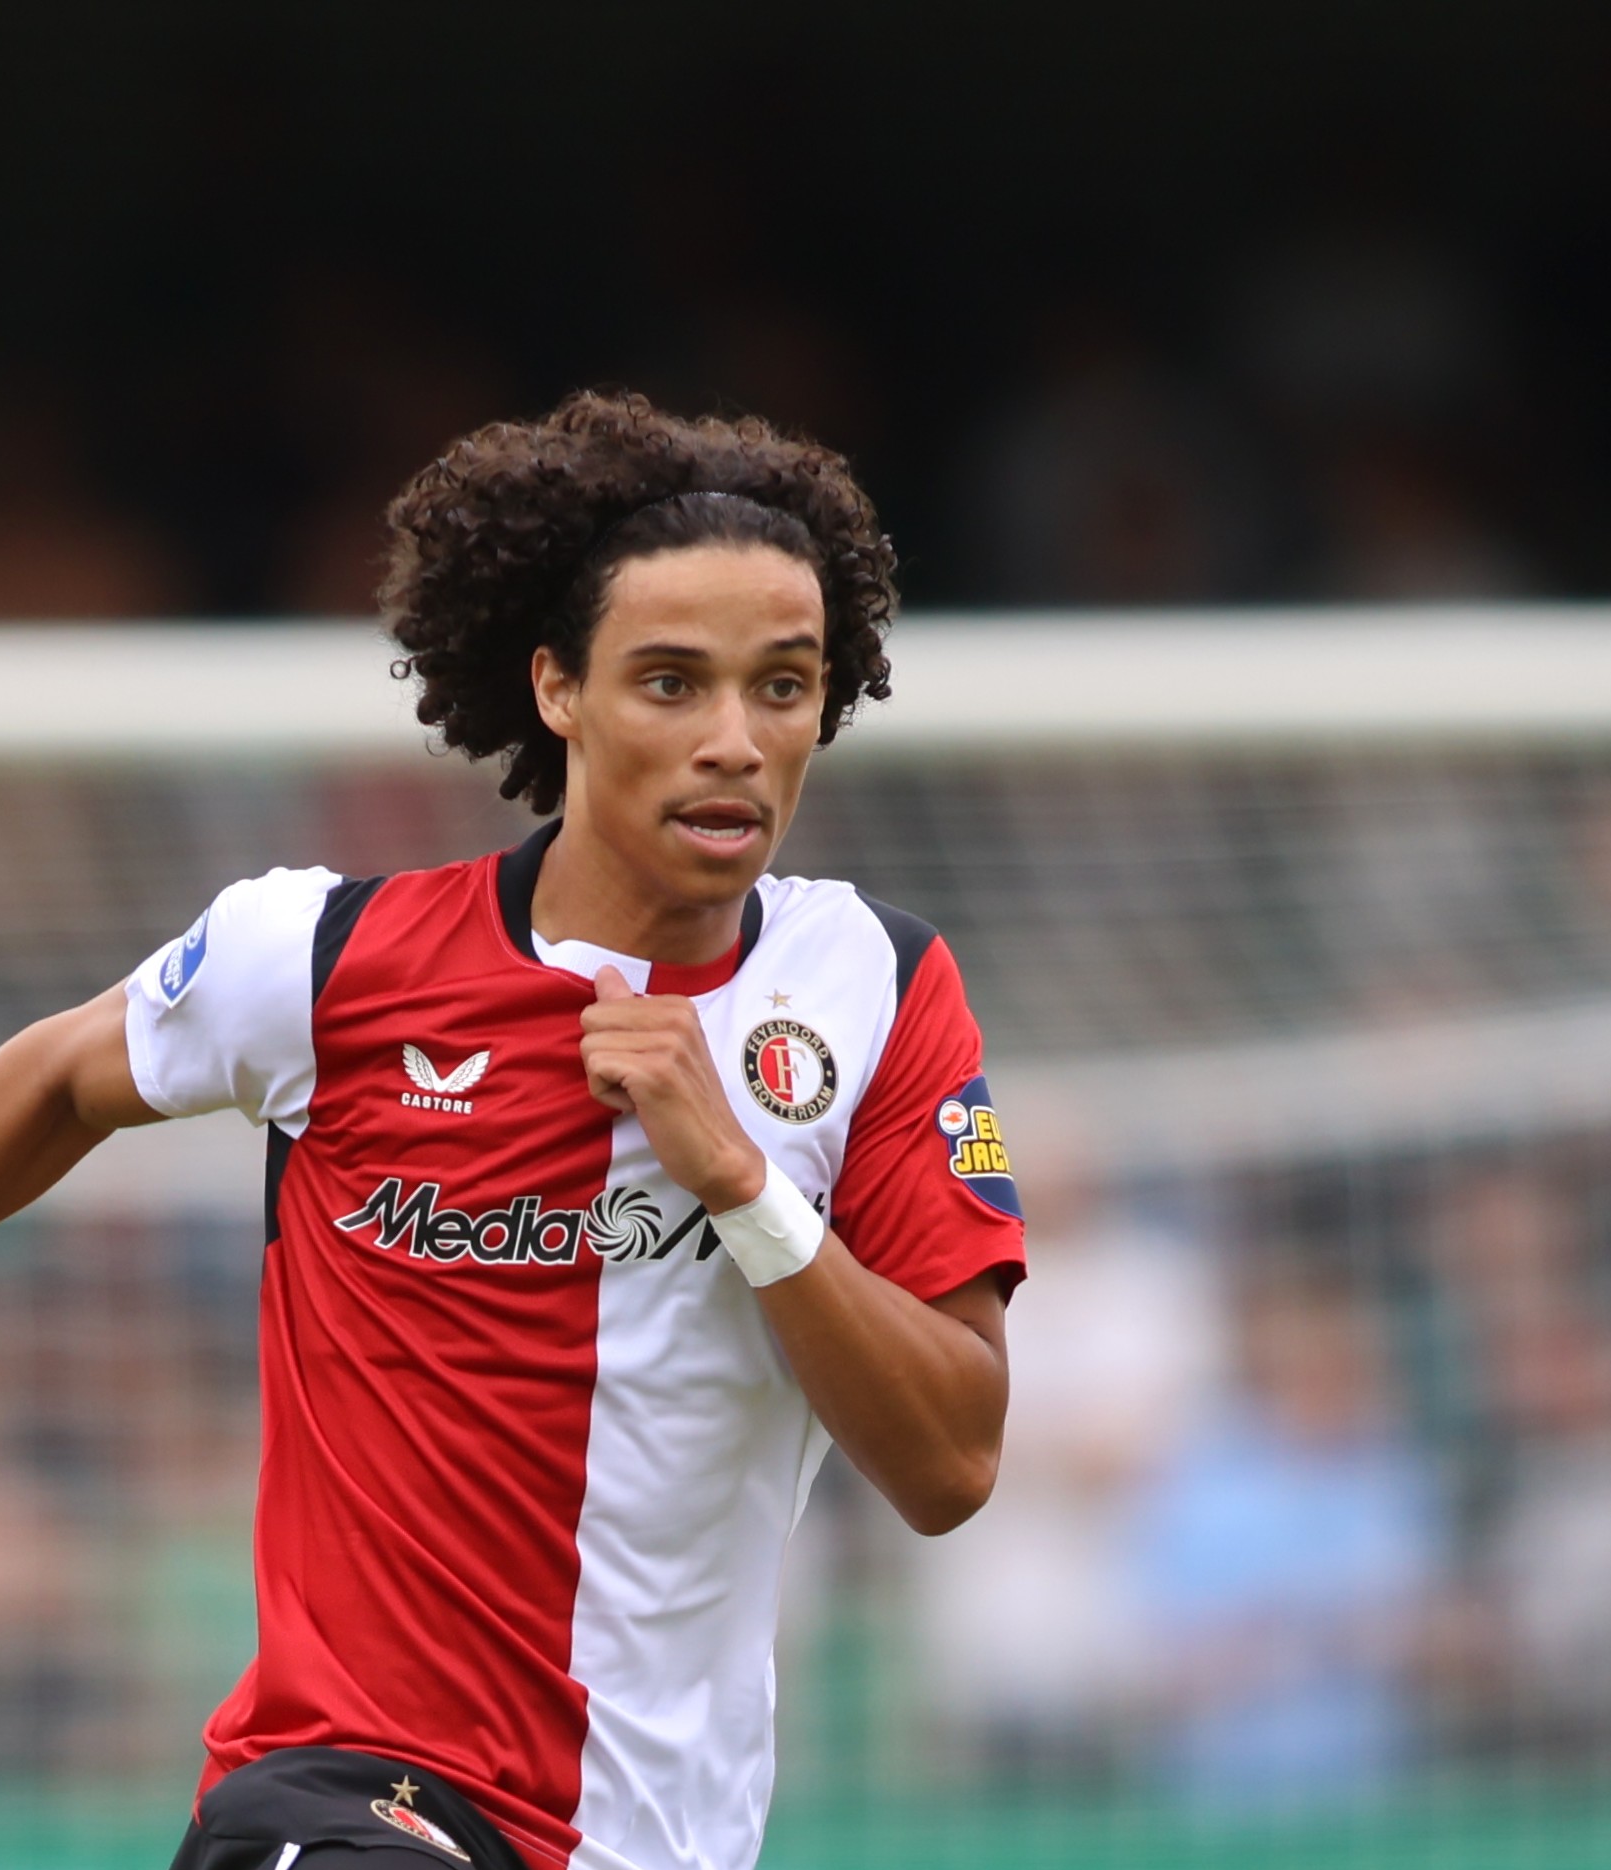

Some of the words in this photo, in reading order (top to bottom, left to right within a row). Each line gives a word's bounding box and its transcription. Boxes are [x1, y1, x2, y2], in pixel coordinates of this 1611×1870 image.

[746, 1020, 830, 1060] FEYENOORD
[401, 1092, 473, 1115] CASTORE
[750, 1079, 835, 1120] ROTTERDAM
[334, 1177, 584, 1266] Media
